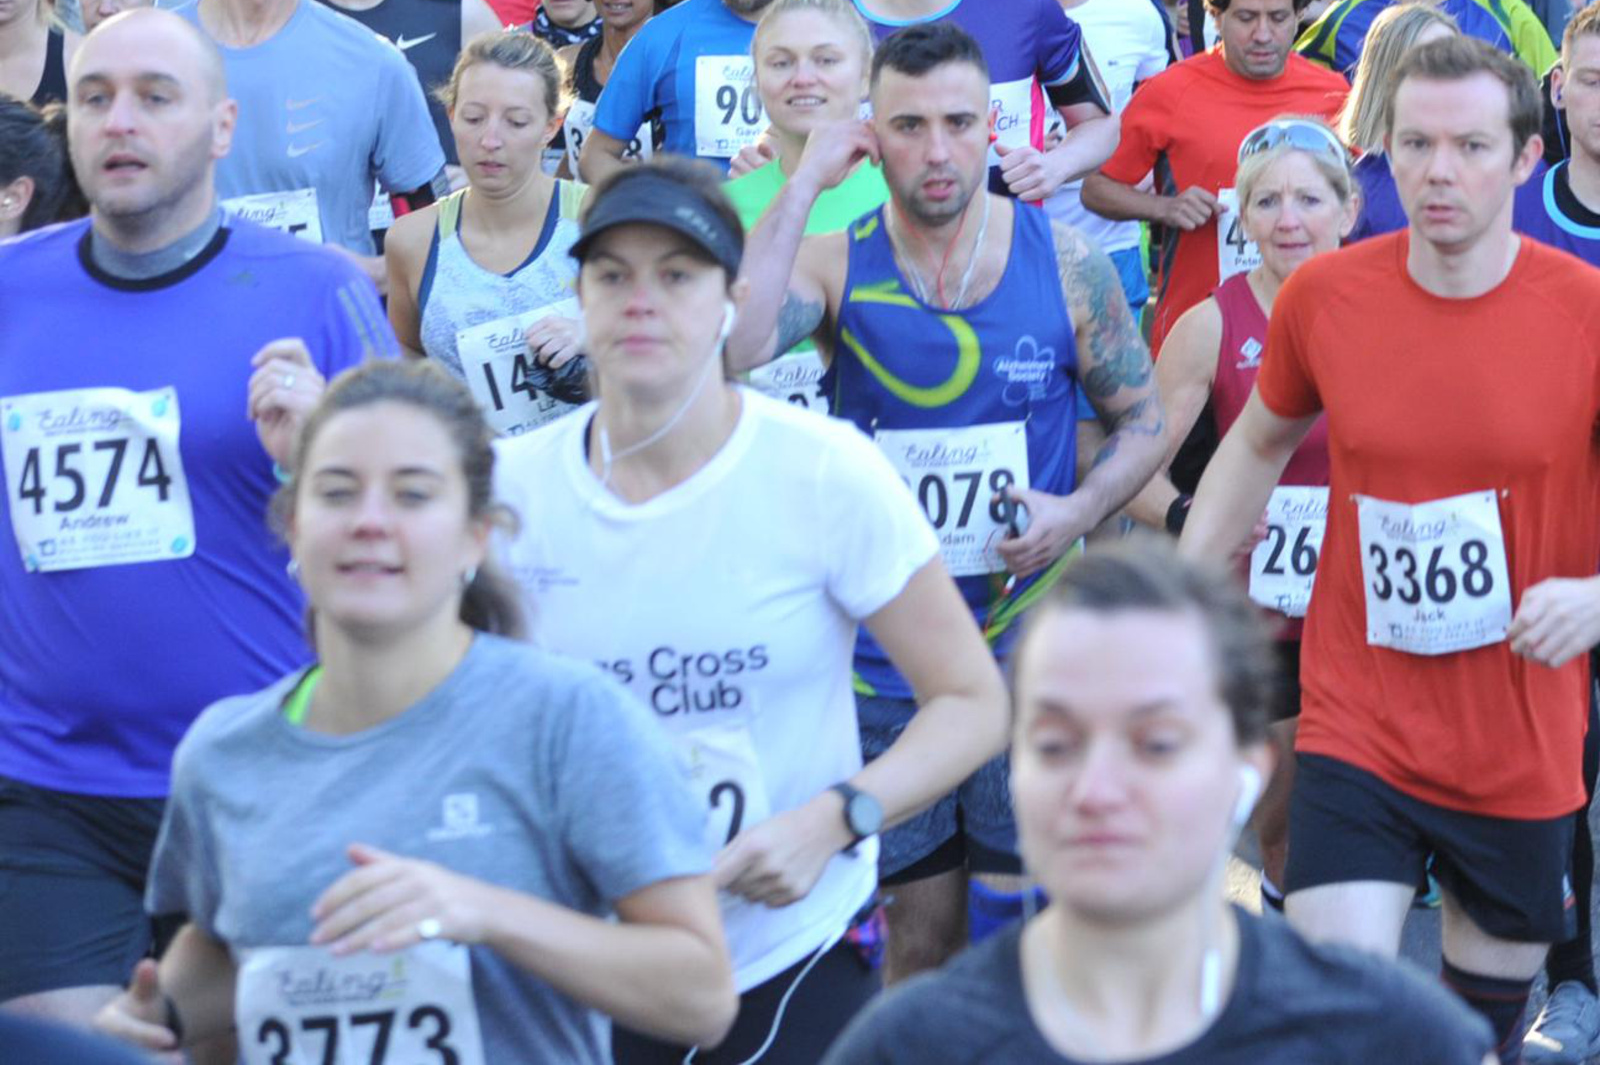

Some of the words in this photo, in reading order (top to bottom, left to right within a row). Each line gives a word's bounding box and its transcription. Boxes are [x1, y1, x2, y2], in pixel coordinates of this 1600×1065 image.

[19, 437, 172, 516] 4574
[901, 468, 1015, 529] 078
[59, 512, 130, 531] Andrew
[1262, 525, 1318, 576] 26
[1369, 539, 1494, 605] 3368
[1413, 608, 1446, 622] Jack
[648, 643, 769, 681] Cross
[650, 679, 743, 717] Club
